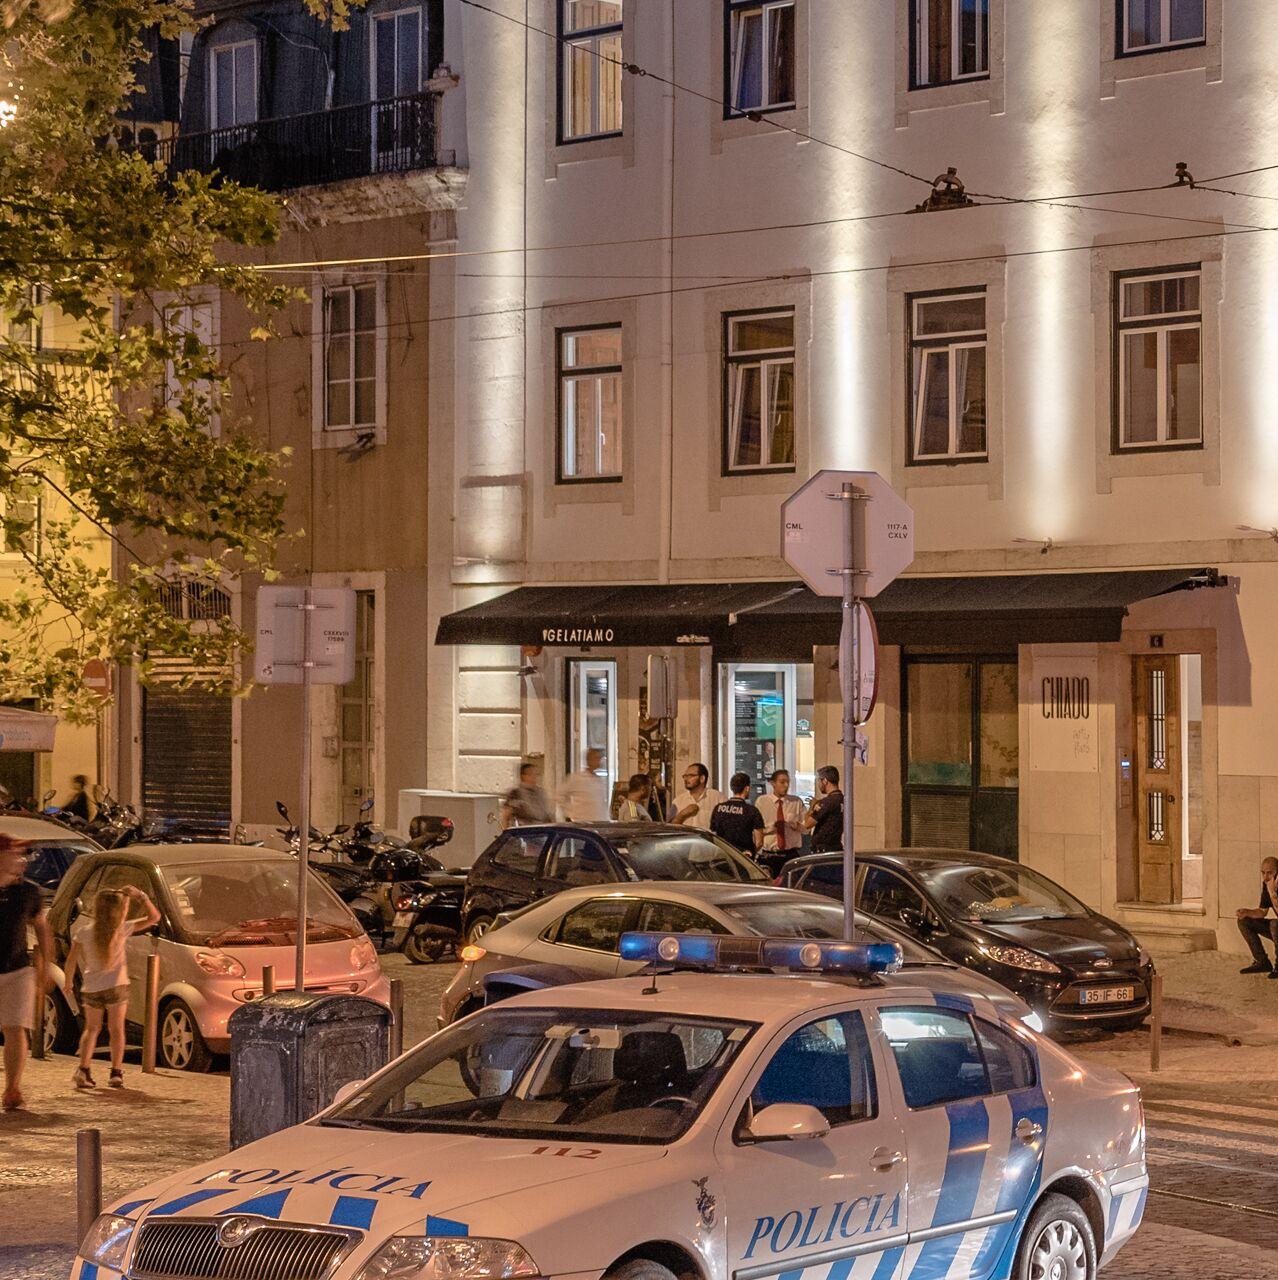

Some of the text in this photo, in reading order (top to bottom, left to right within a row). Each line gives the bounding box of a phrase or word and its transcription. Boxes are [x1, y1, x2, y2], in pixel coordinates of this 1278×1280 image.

[786, 522, 804, 530] CML
[547, 628, 614, 642] GELATIAMO
[1042, 676, 1090, 719] CHIADO
[529, 1146, 603, 1160] 112
[192, 1166, 433, 1200] POLÍCIA
